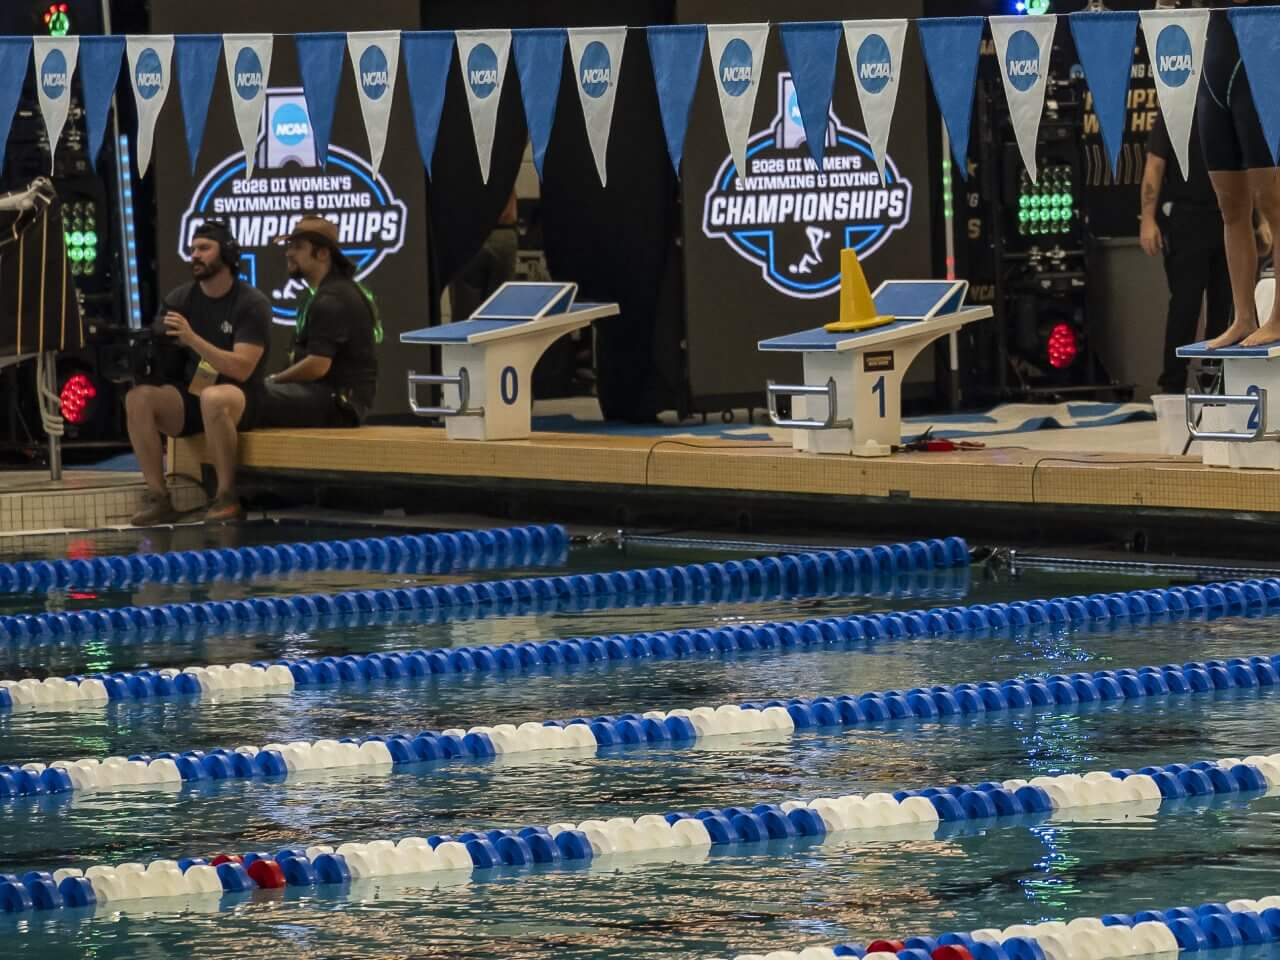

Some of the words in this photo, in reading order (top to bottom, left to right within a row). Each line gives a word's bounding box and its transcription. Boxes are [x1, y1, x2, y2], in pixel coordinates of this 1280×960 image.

[860, 63, 890, 79] NCAA
[1009, 59, 1040, 76] NCAA
[1160, 54, 1193, 71] NCAA
[43, 73, 68, 86] NCAA
[137, 73, 162, 87] NCAA
[236, 72, 263, 87] NCAA
[362, 71, 389, 86] NCAA
[471, 69, 498, 84] NCAA
[582, 68, 610, 84] NCAA
[723, 67, 752, 82] NCAA
[275, 123, 309, 136] NCAA
[752, 158, 785, 174] 2026
[787, 157, 802, 173] DI
[804, 156, 861, 172] WMEN'S
[232, 178, 268, 194] 2026
[270, 177, 287, 193] DI
[289, 176, 352, 193] WOMEN'S
[735, 174, 814, 191] SWIMMING
[817, 173, 828, 188] &
[830, 171, 879, 187] DIVING
[214, 194, 301, 212] SWIMMING
[304, 194, 315, 210] &
[317, 192, 371, 209] DIVING
[710, 189, 905, 225] CHAMPIONSHIPS
[187, 211, 399, 248] CMPIOHIPS
[500, 365, 519, 405] 0
[871, 375, 886, 418] 1
